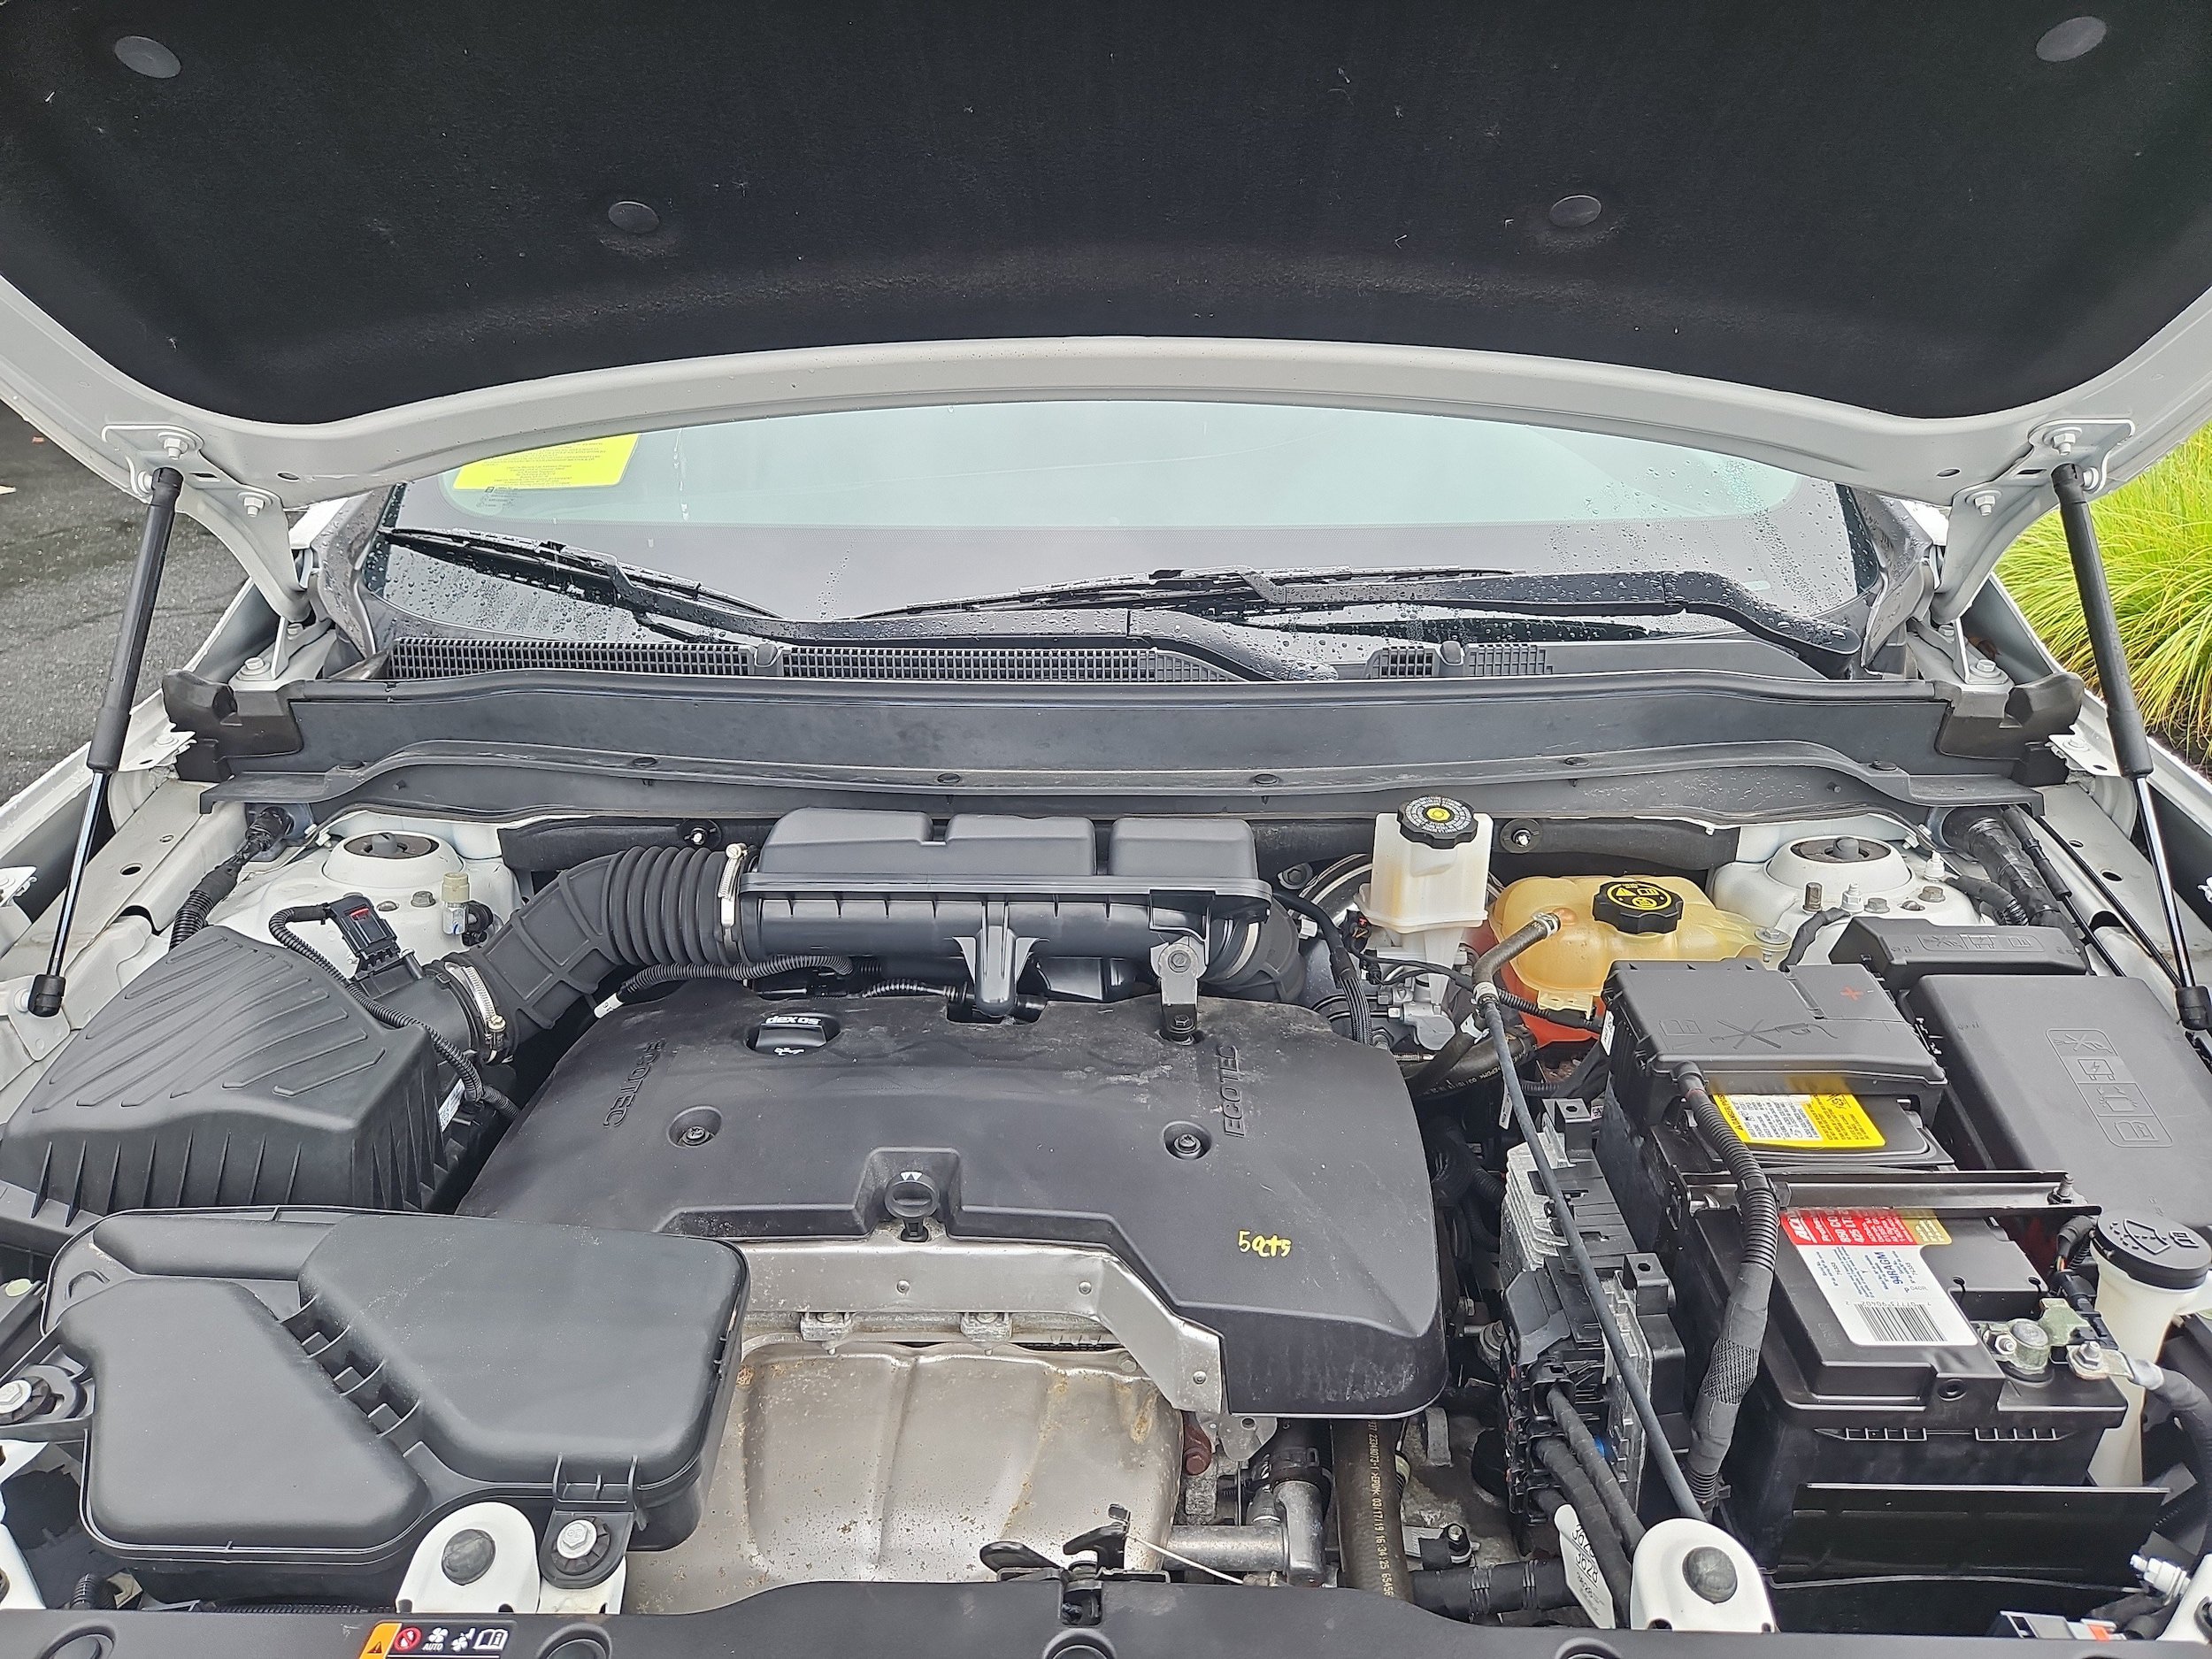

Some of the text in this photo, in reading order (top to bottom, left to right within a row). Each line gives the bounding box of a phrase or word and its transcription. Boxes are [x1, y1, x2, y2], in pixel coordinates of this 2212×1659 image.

[765, 1016, 821, 1025] dexos
[1217, 1045, 1246, 1138] ECOTEC
[1834, 1229, 1851, 1242] 850
[1848, 1229, 1865, 1242] 425
[1873, 1251, 1904, 1284] 94RAGM
[1371, 1497, 1383, 1532] 03/17/19
[1375, 1534, 1390, 1570] 16:34:25
[422, 1642, 444, 1651] AUTO
